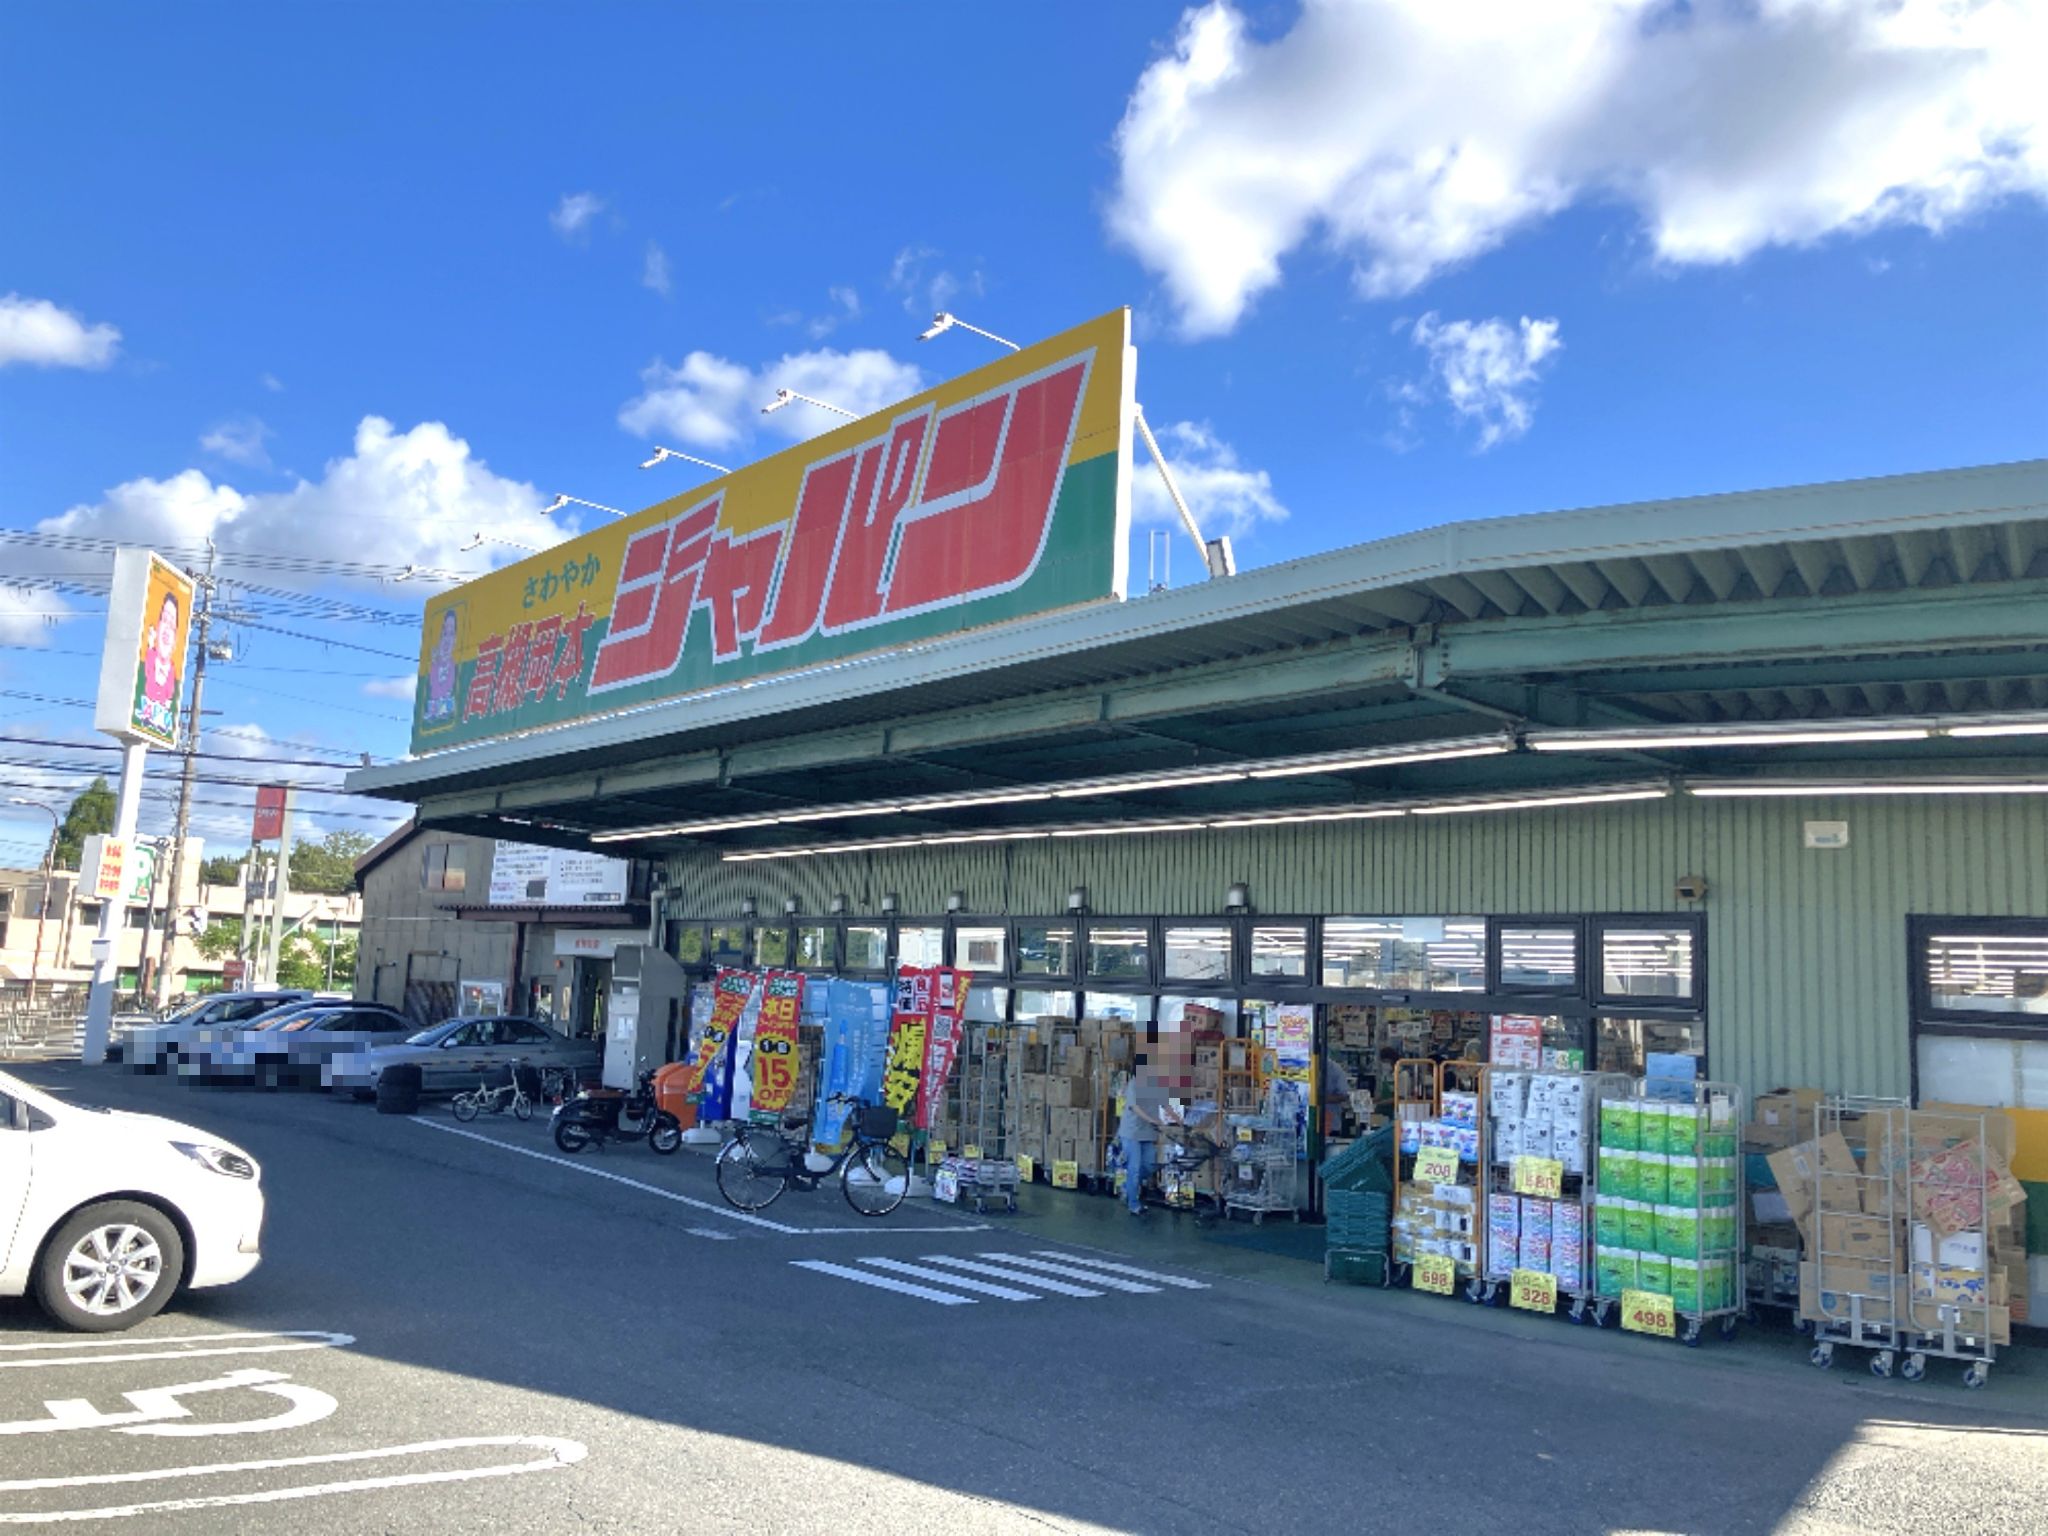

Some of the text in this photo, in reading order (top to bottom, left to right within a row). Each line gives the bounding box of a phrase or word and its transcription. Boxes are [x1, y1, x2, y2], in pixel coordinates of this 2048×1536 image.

[586, 346, 1098, 696] ジャパン
[522, 553, 601, 609] さわやか
[763, 997, 797, 1021] 本日
[757, 1056, 792, 1089] 15
[1633, 1309, 1668, 1328] 498
